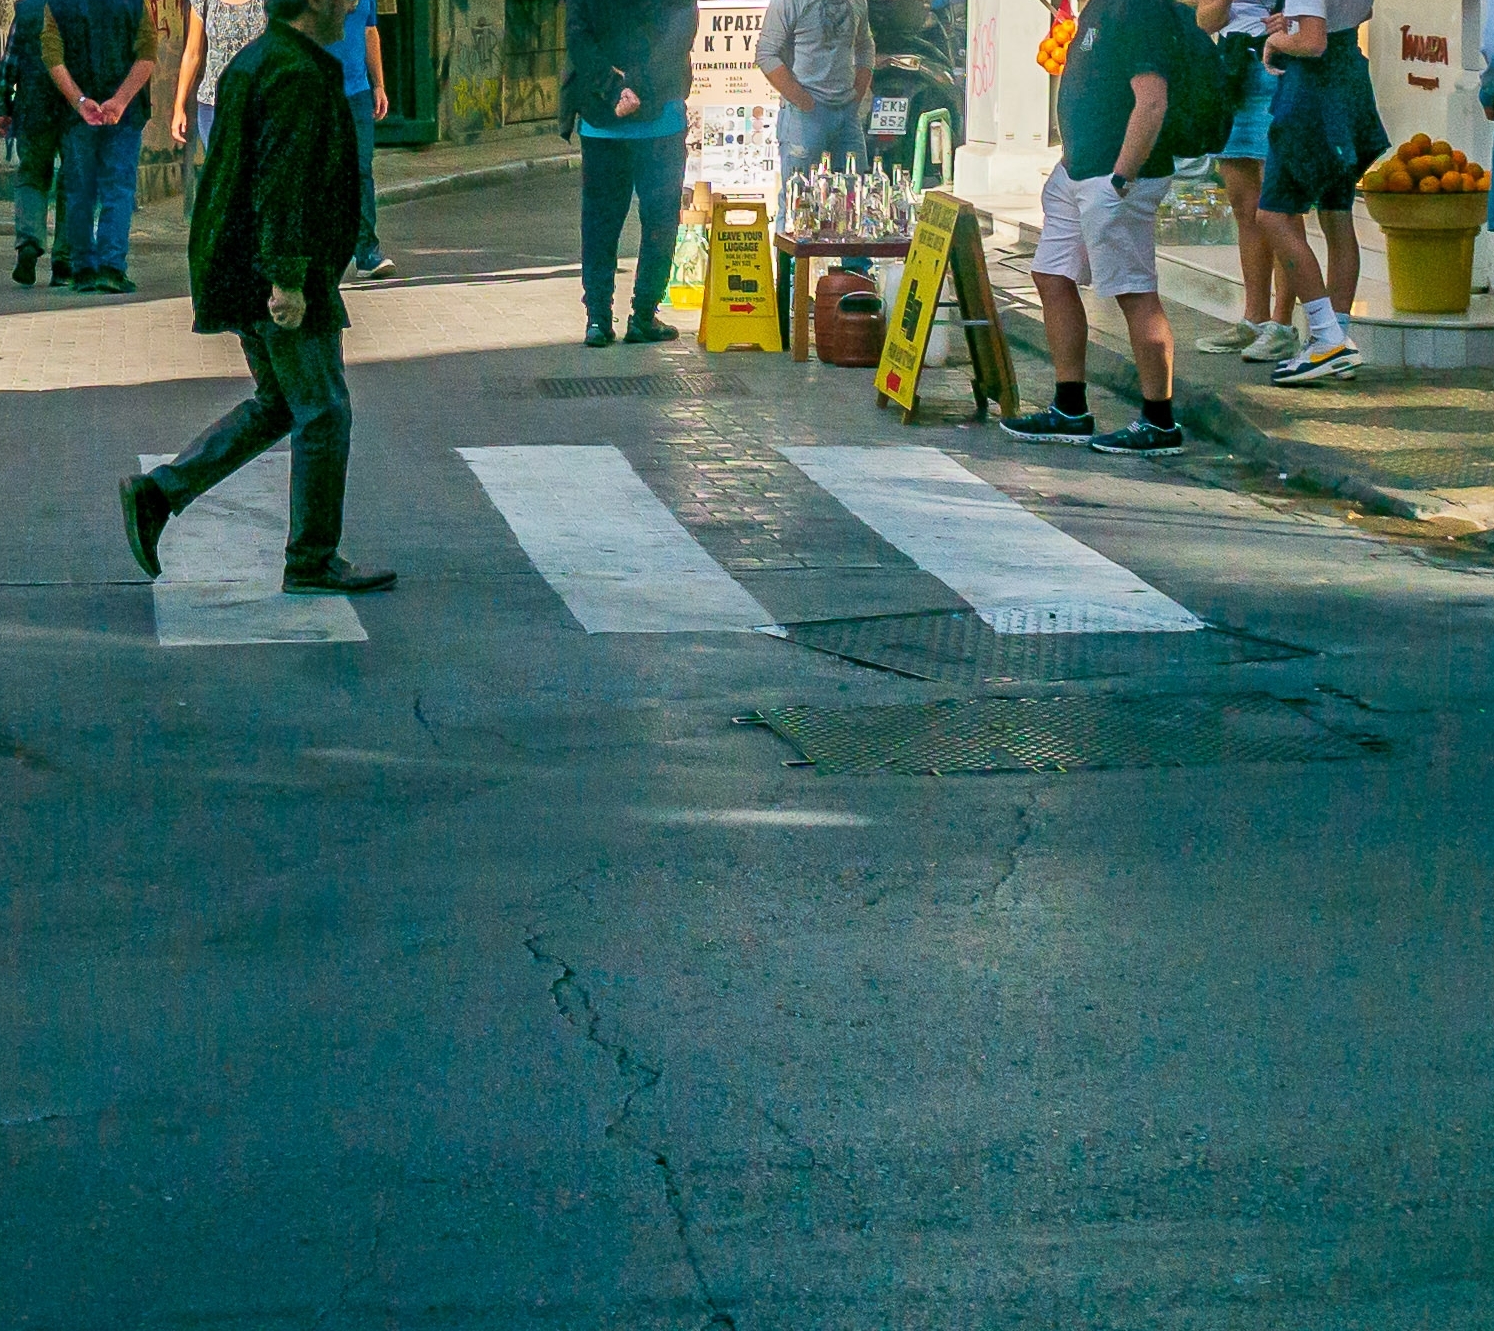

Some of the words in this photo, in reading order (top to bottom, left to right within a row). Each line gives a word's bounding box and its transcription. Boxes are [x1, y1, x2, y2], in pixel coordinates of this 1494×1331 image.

[880, 116, 904, 127] 852
[718, 231, 742, 242] LEAVE
[743, 231, 763, 242] YOUR
[724, 242, 759, 252] LUGGAGE
